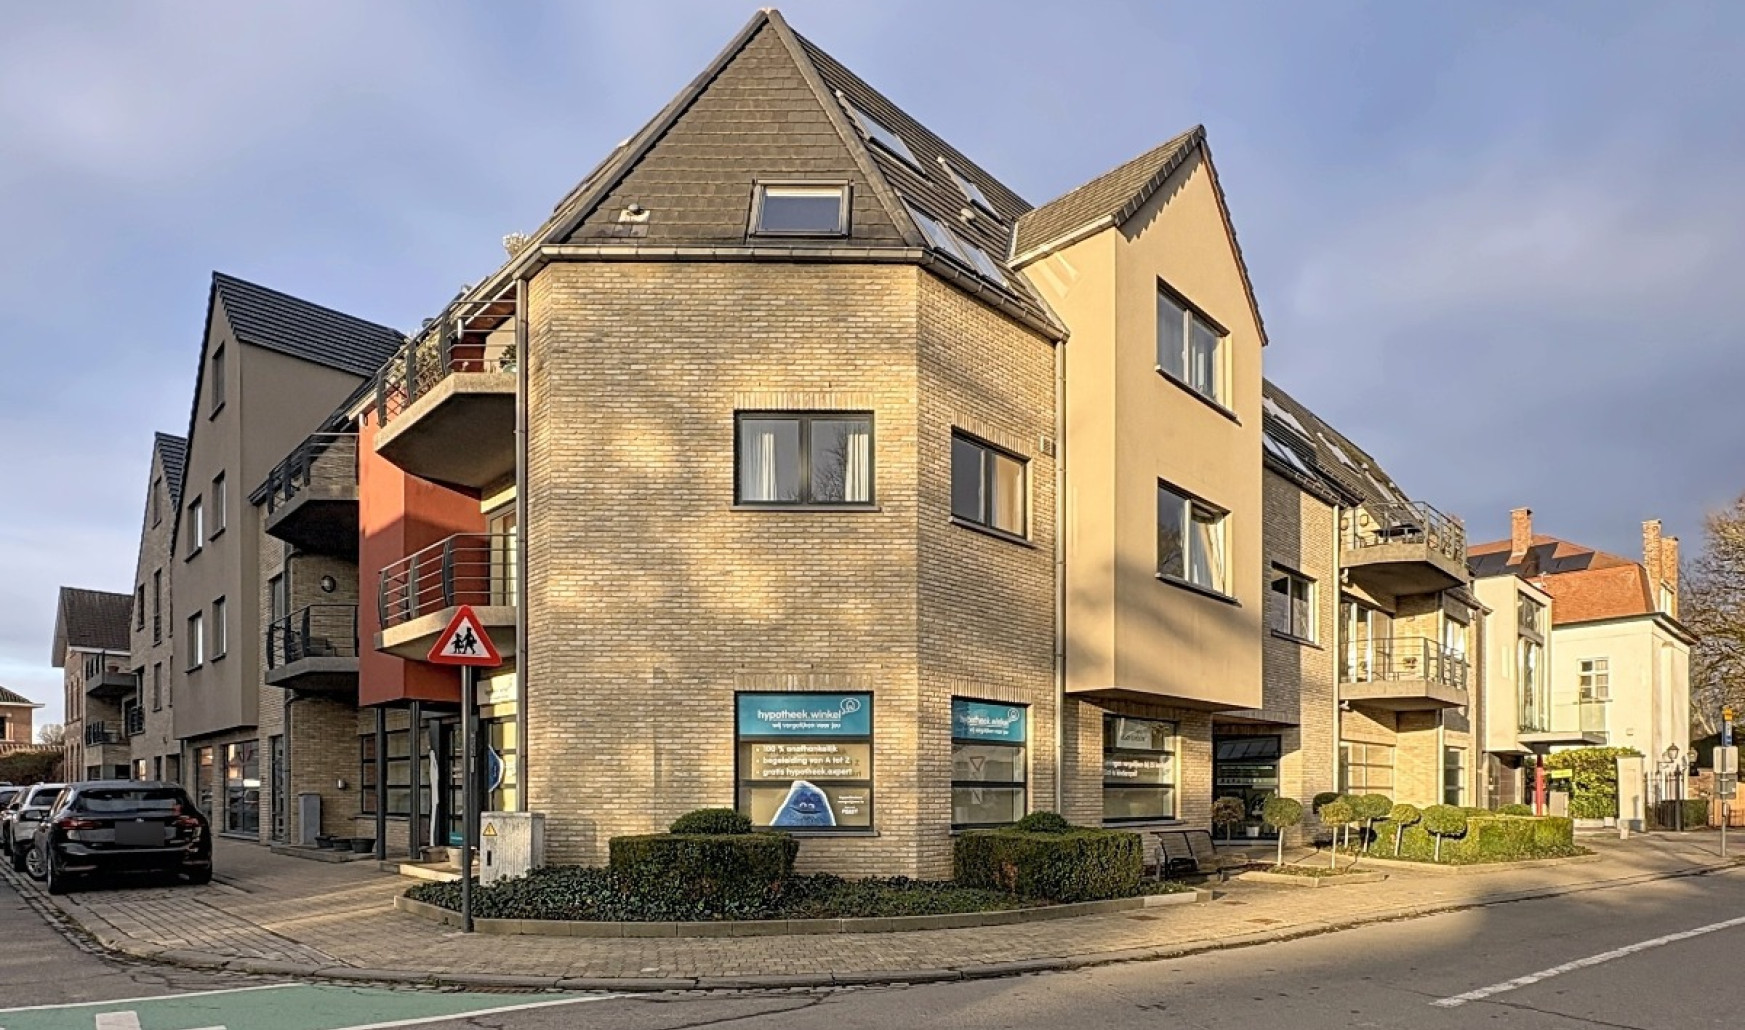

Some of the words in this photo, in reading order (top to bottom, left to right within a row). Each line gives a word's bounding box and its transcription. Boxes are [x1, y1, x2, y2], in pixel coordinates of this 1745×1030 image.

[757, 709, 841, 721] hypotheek.winkel
[762, 756, 808, 765] begeleiding
[762, 768, 785, 776] gratis
